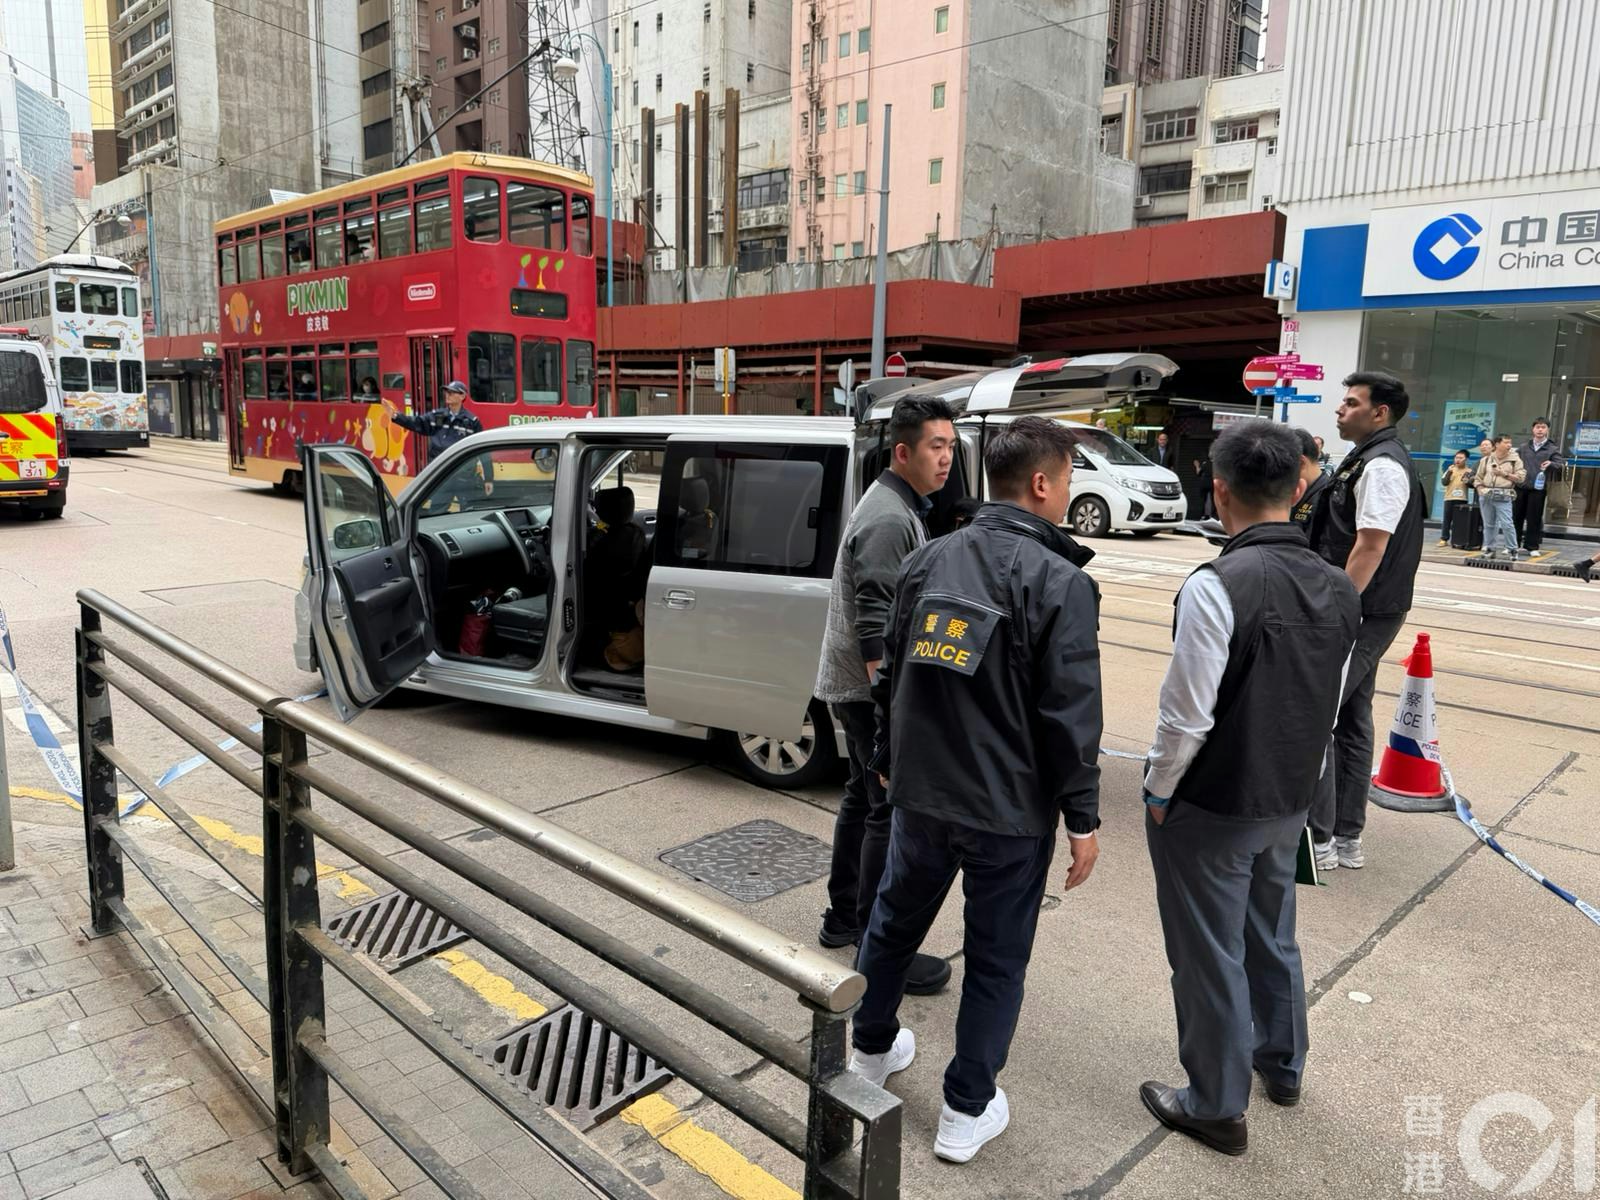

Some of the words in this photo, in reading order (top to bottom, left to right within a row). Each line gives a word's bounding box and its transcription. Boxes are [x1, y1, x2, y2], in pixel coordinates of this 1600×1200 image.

[1500, 210, 1600, 248] 中国
[1499, 251, 1564, 270] China
[287, 276, 348, 316] PIKMIN
[29, 460, 36, 469] C
[912, 641, 971, 667] POLICE
[1406, 691, 1422, 707] 察
[1395, 709, 1422, 728] LICE
